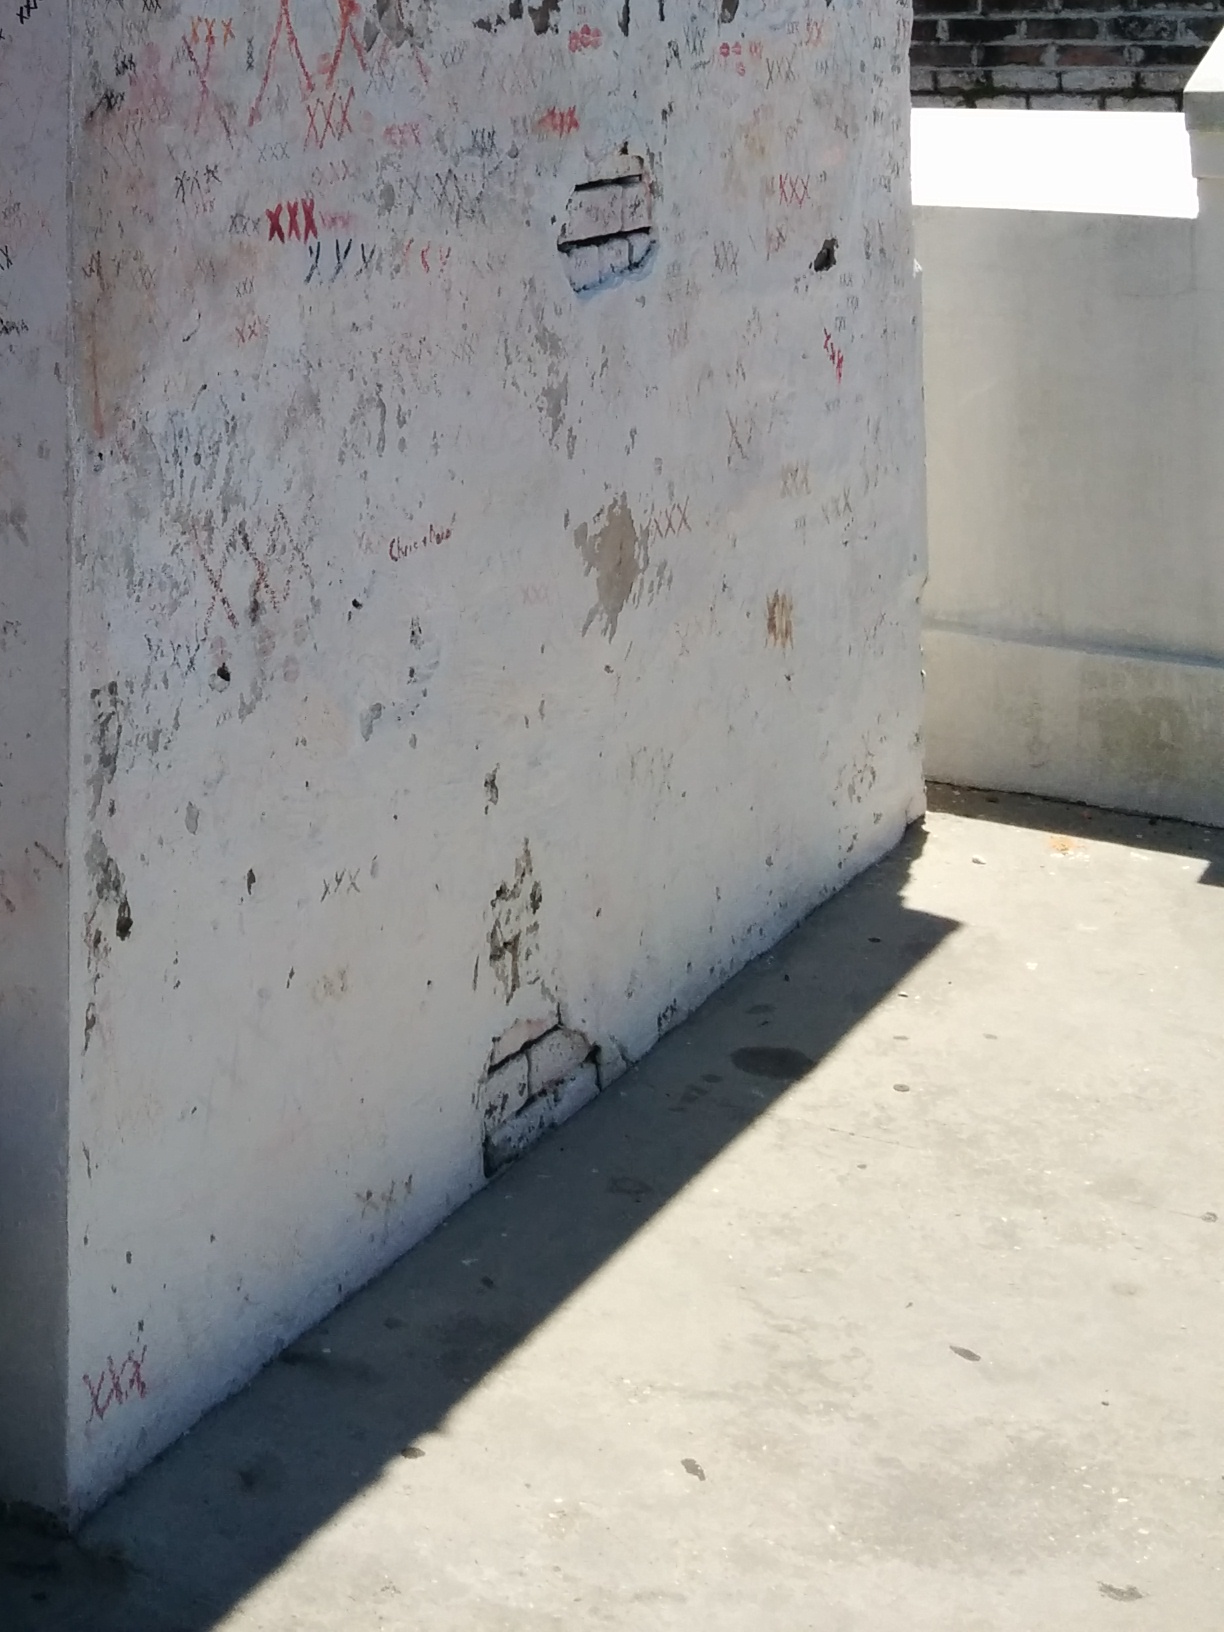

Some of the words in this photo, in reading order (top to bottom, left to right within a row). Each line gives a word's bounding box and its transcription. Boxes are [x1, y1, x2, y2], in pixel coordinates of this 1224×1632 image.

[779, 172, 810, 208] XXX
[266, 197, 319, 244] XXX
[83, 1344, 147, 1421] XXX
